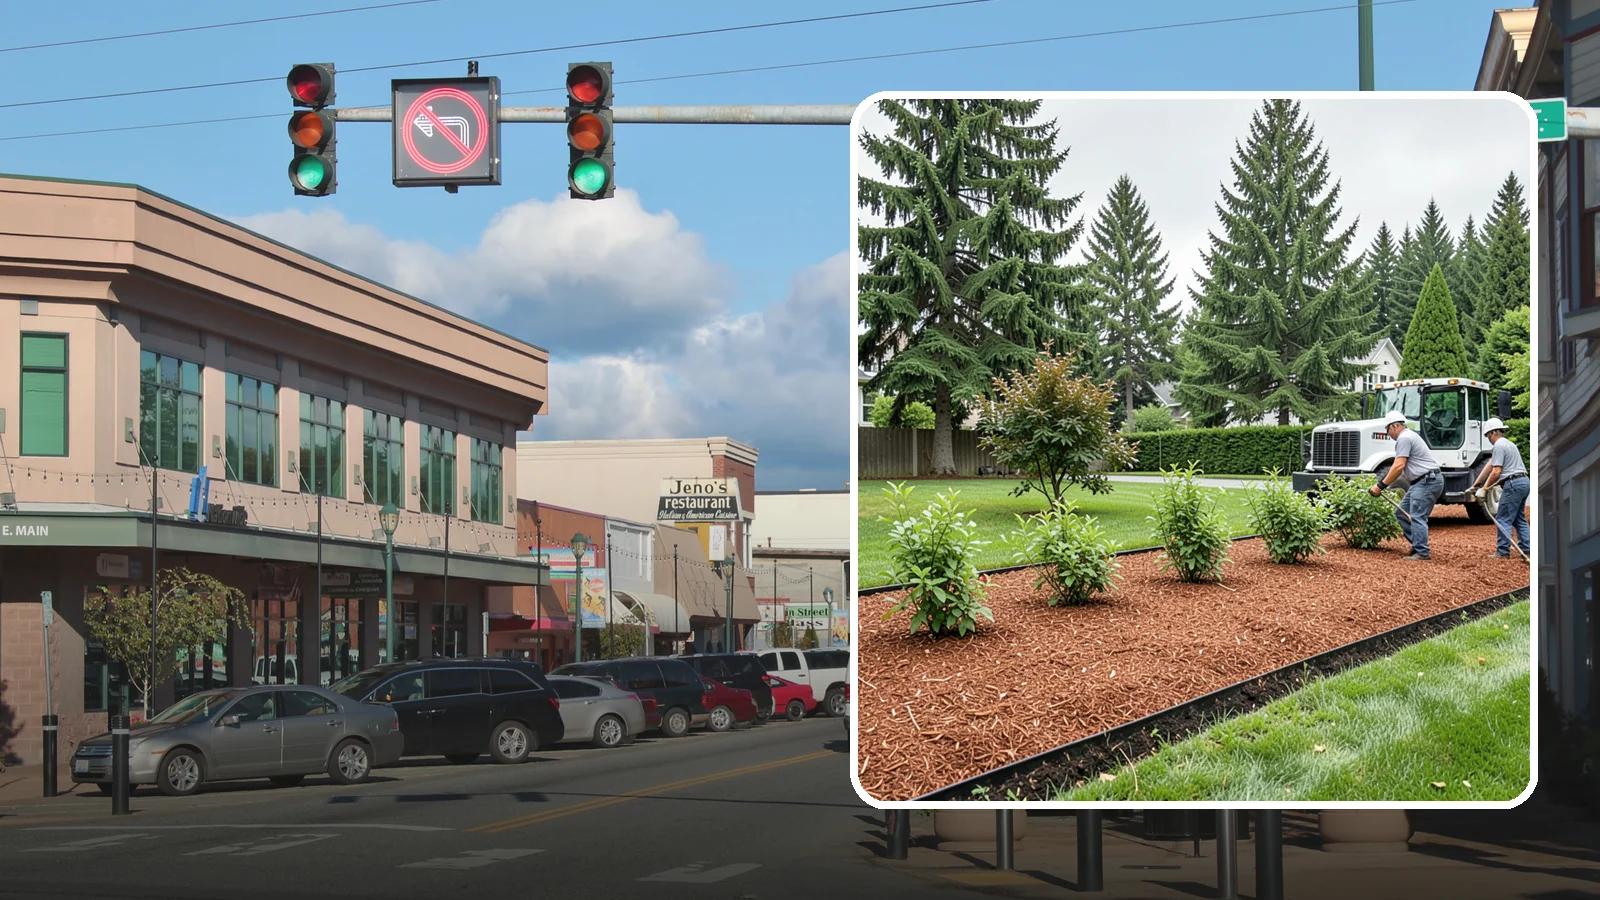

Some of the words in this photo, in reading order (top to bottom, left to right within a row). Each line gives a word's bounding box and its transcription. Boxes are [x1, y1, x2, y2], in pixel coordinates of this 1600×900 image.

[670, 480, 728, 495] Jeno's
[665, 496, 731, 509] restaurant
[659, 510, 682, 520] Italian
[686, 510, 715, 520] American
[715, 509, 738, 519] Cuisine
[2, 525, 13, 536] E.
[15, 525, 49, 536] MAIN
[798, 607, 828, 616] Street
